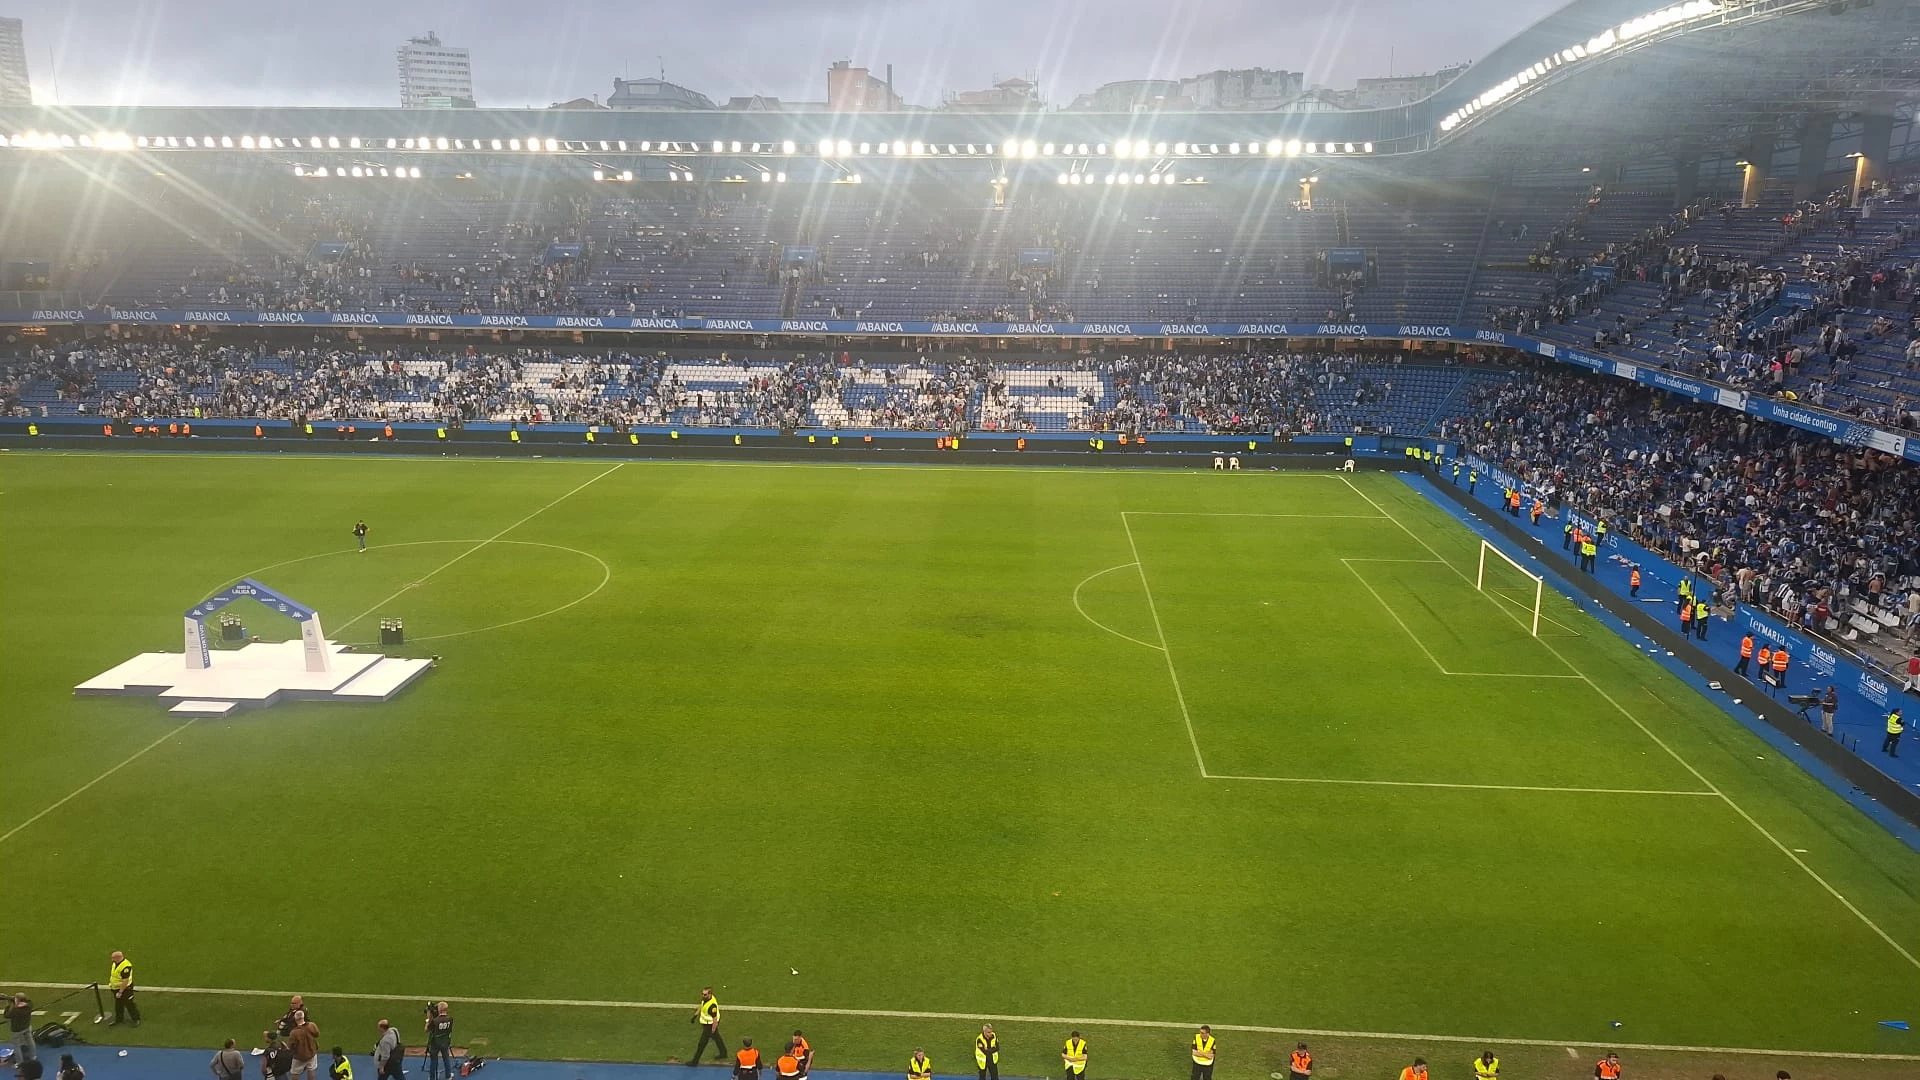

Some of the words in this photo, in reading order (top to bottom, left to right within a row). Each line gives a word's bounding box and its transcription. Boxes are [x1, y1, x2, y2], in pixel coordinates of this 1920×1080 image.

[1655, 374, 1666, 385] Unha
[1667, 376, 1682, 389] cidade
[1683, 382, 1701, 395] contigo
[1773, 405, 1789, 419] Unha
[1790, 409, 1811, 425] cidade
[1811, 417, 1838, 433] contigo
[1811, 644, 1816, 653] A
[1817, 647, 1836, 664] Coruña
[1860, 672, 1866, 681] A
[1866, 675, 1888, 693] Coruña
